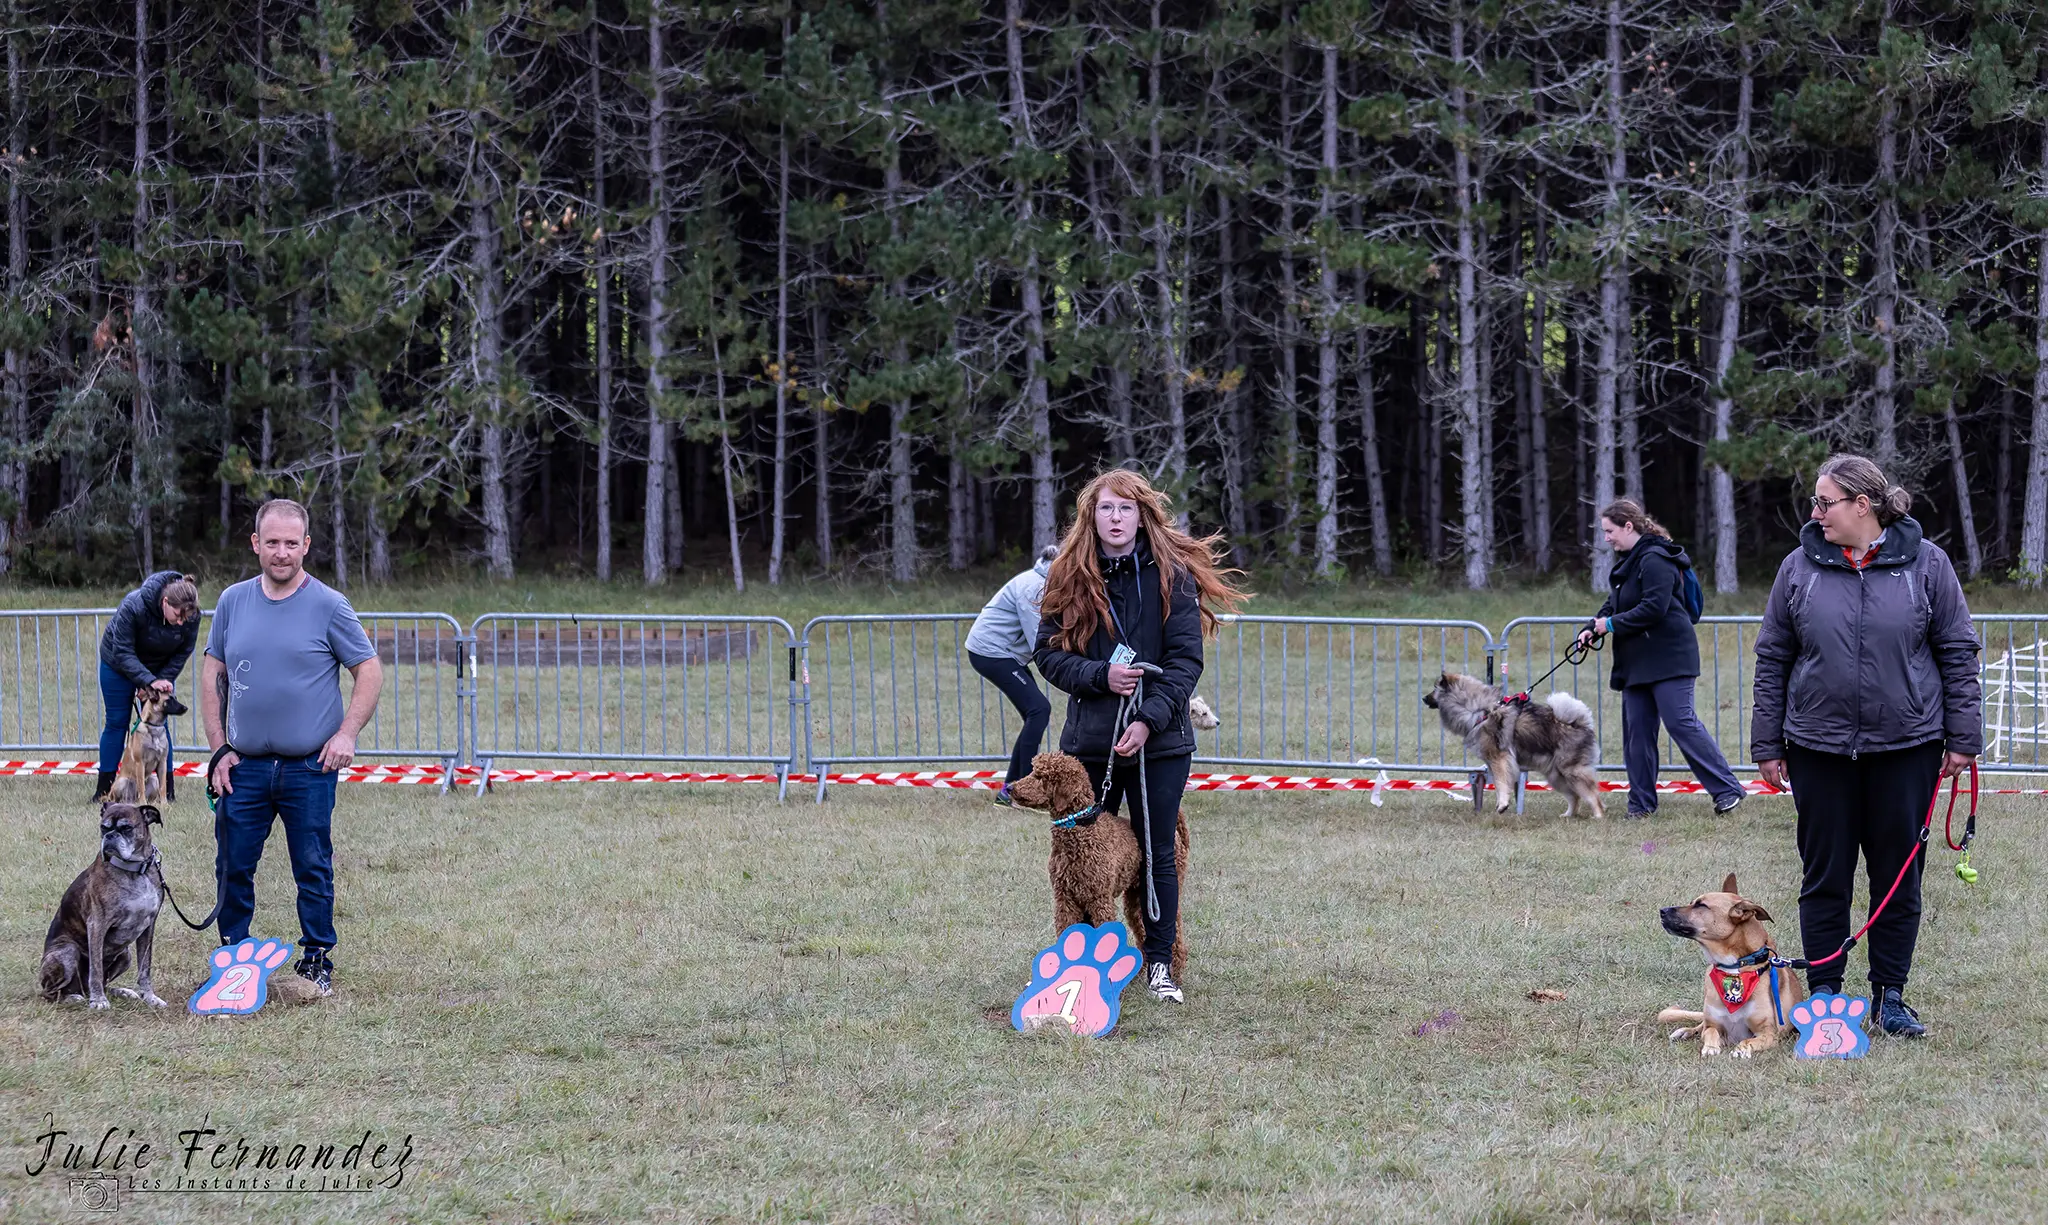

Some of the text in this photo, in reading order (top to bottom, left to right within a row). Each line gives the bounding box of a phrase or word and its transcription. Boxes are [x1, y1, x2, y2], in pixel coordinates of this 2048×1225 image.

[216, 967, 253, 1001] 2
[1052, 980, 1083, 1025] 1
[1819, 1022, 1844, 1054] 3
